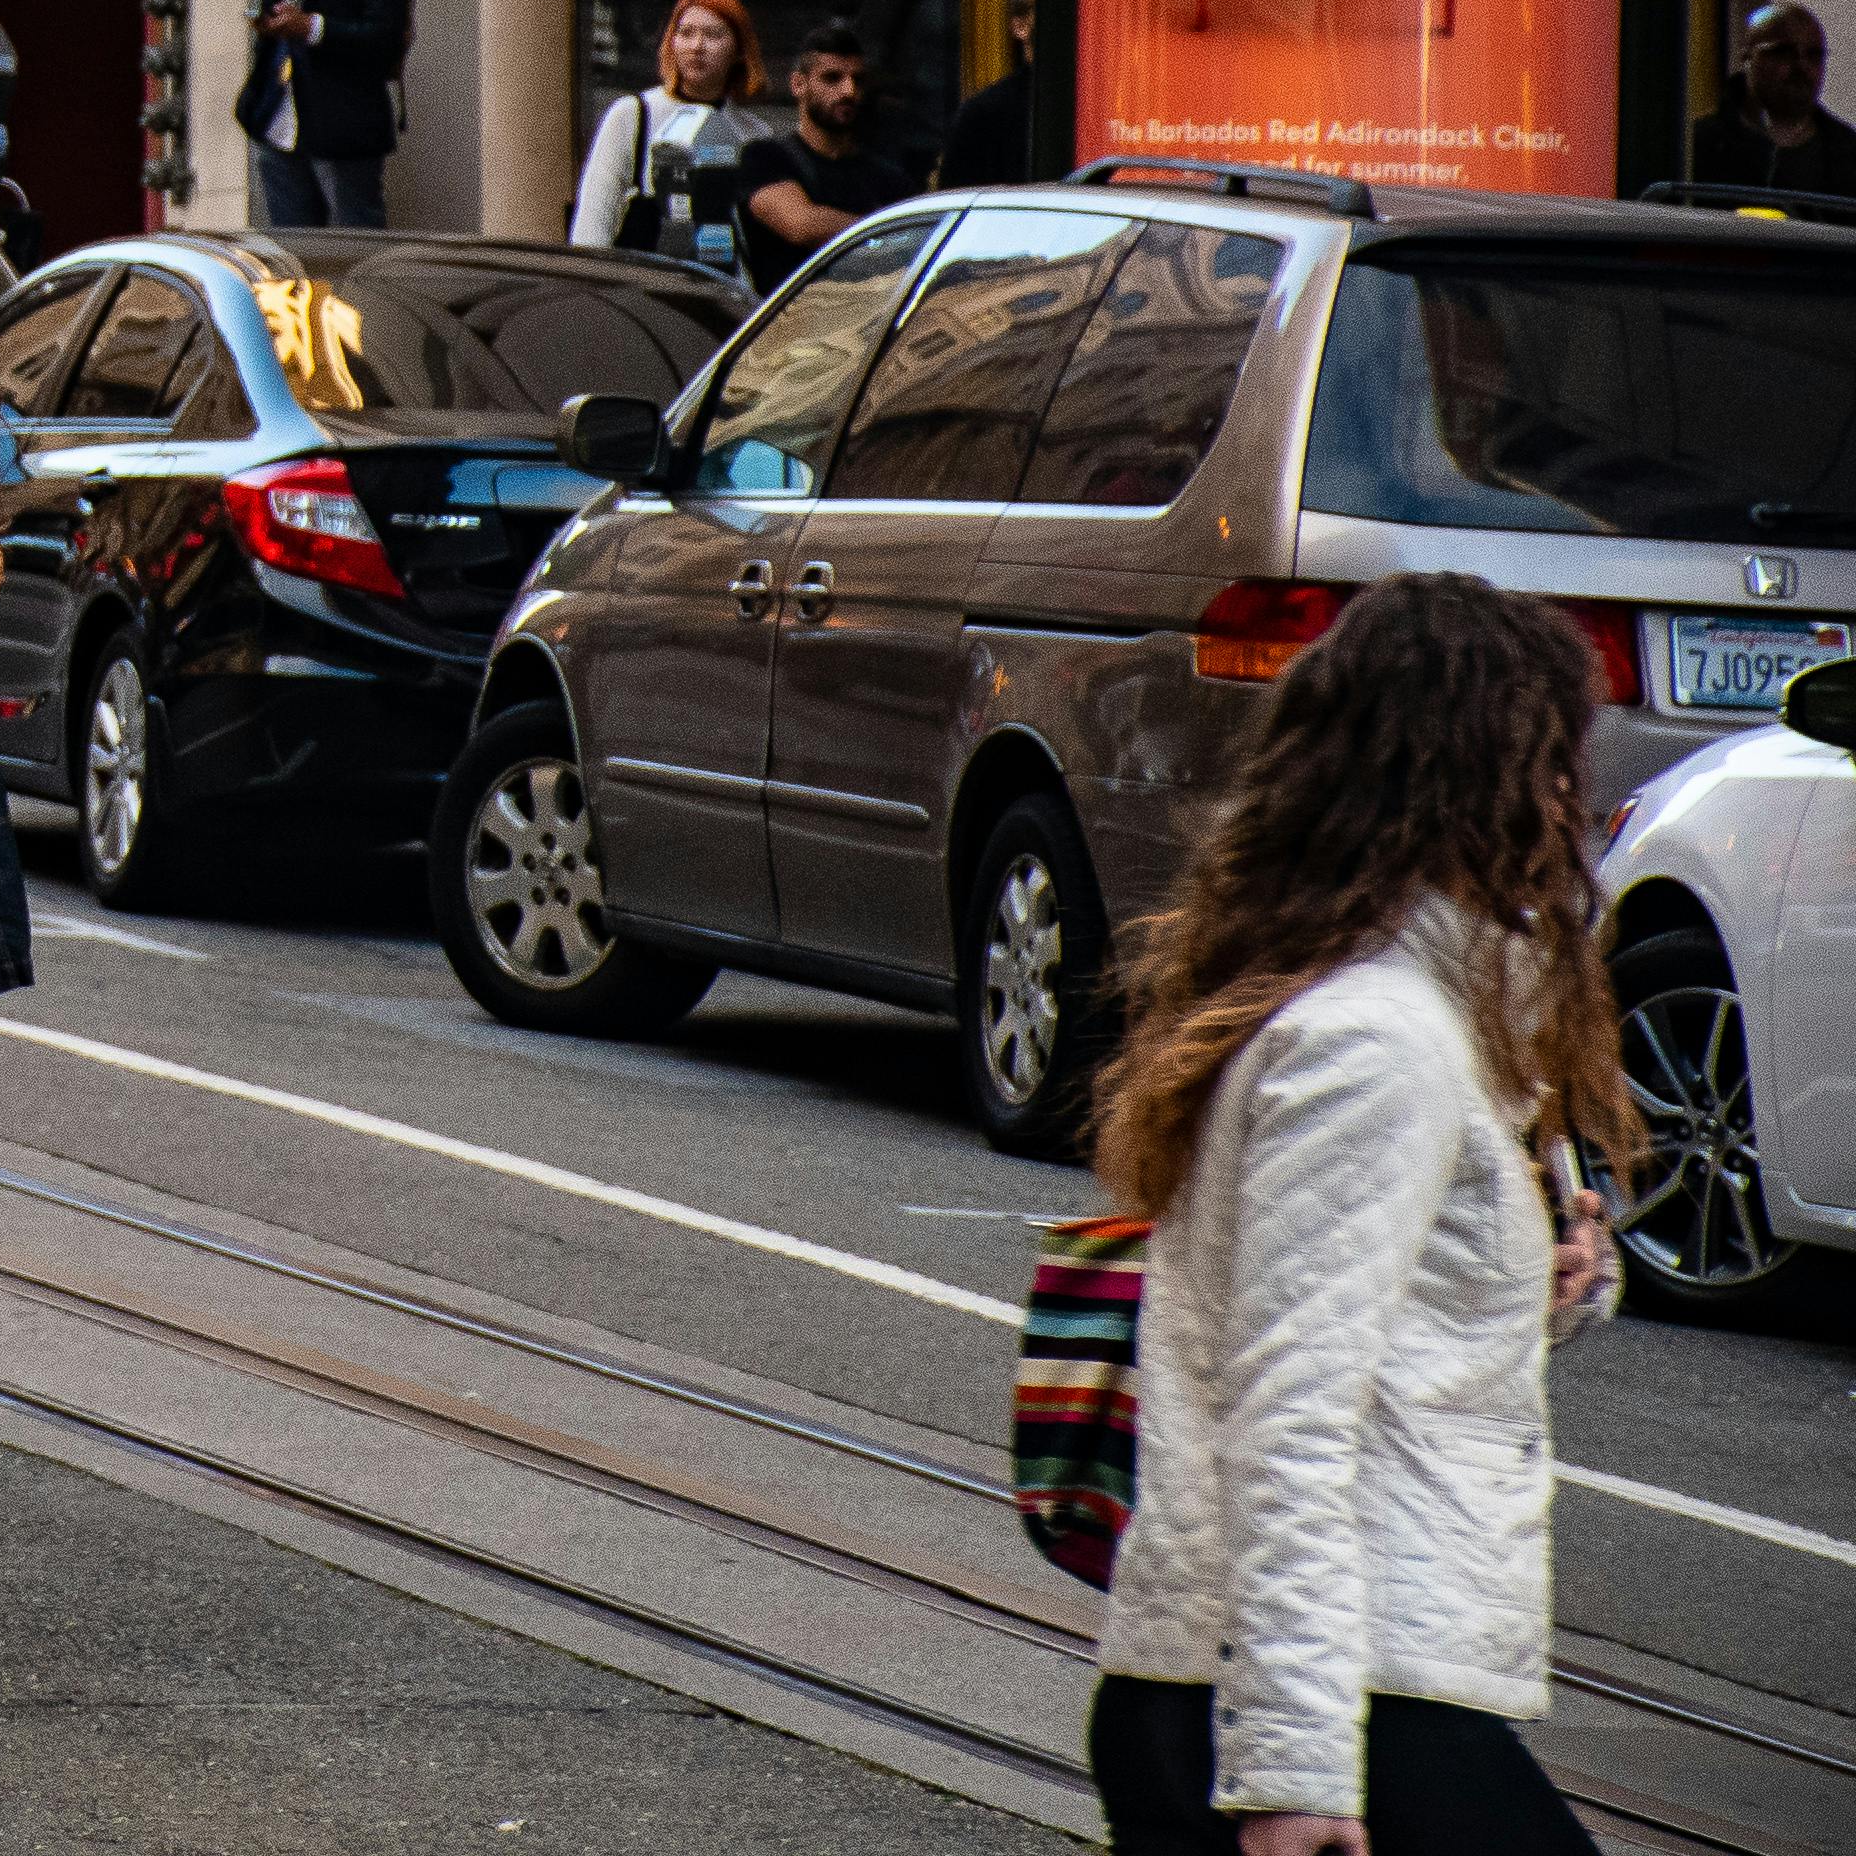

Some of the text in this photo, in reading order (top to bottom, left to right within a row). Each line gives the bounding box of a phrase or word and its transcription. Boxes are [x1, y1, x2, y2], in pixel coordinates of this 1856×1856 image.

[1106, 118, 1142, 143] The
[1147, 119, 1262, 144] Barbados
[1267, 120, 1320, 145] Red
[1326, 120, 1484, 148] Adirondack
